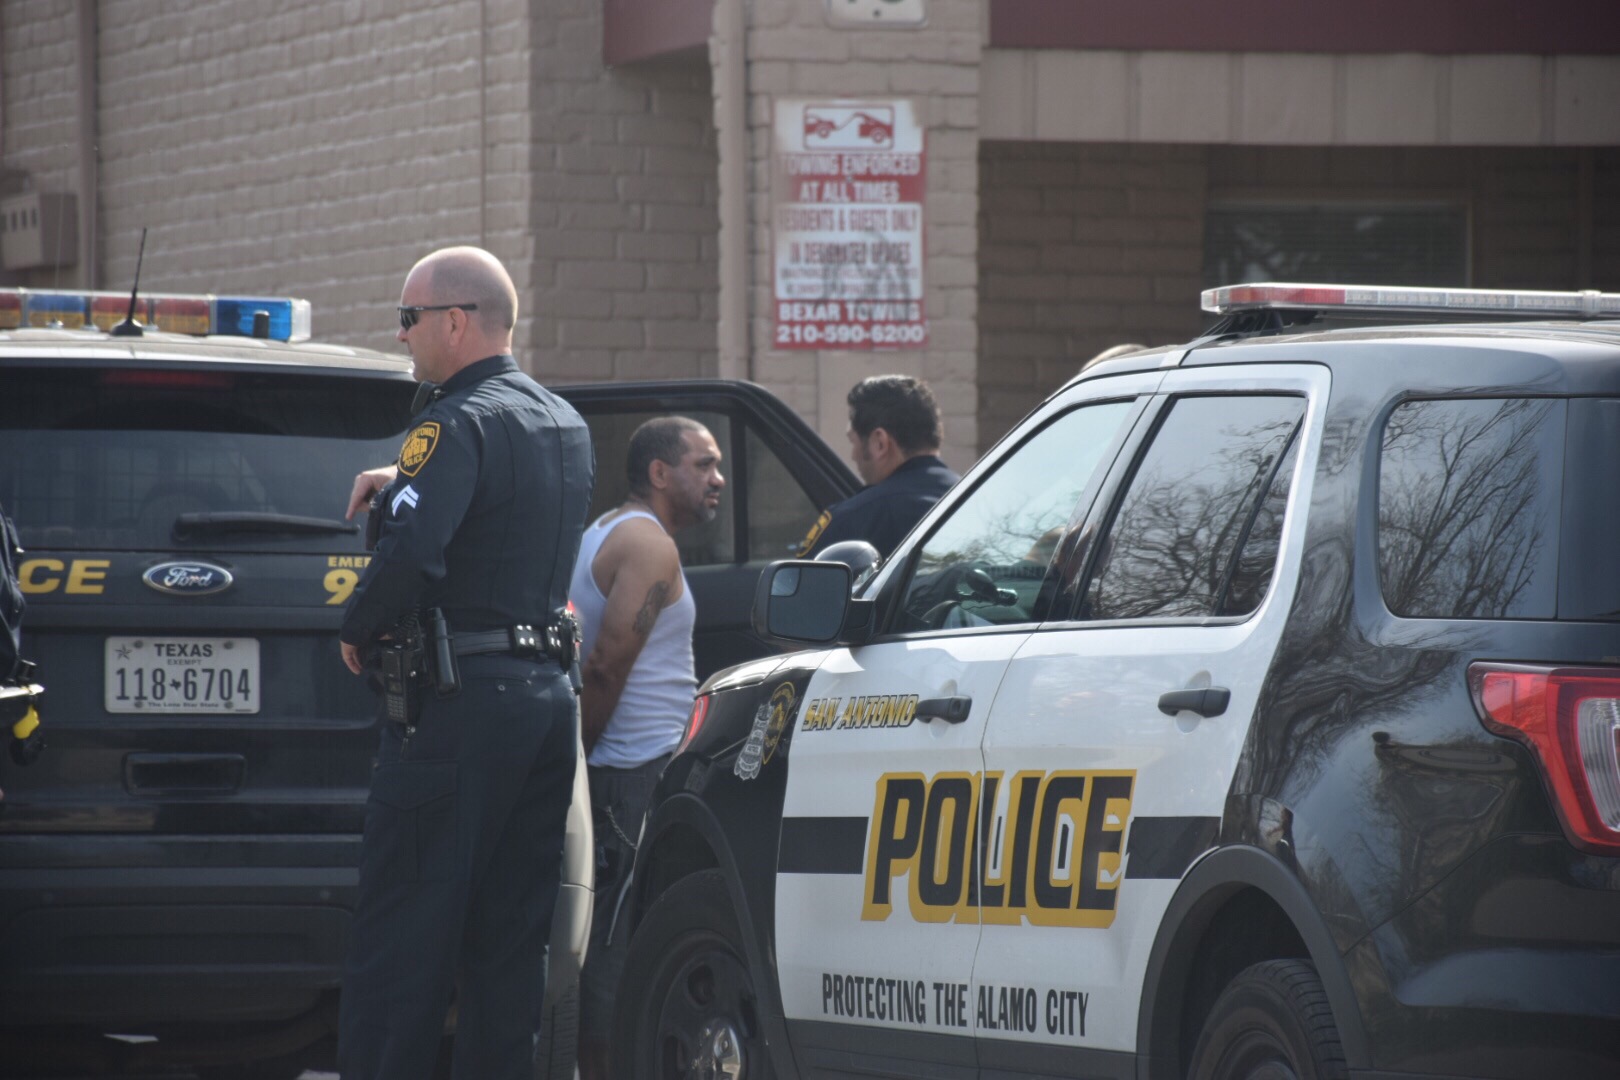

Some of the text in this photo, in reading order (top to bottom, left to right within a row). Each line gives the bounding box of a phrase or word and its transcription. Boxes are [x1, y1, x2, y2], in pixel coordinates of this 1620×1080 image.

[800, 181, 900, 202] AT ALL TIMES
[778, 303, 921, 321] BEXAR TOWING
[776, 323, 925, 343] 210-590-6200
[163, 567, 213, 587] Ford
[154, 643, 214, 658] TEXAS
[801, 697, 842, 732] SAN
[837, 693, 919, 730] ANTONIO
[861, 768, 1137, 929] POLICE
[822, 973, 1089, 1037] PROTECTING THE ALAMO CITY
